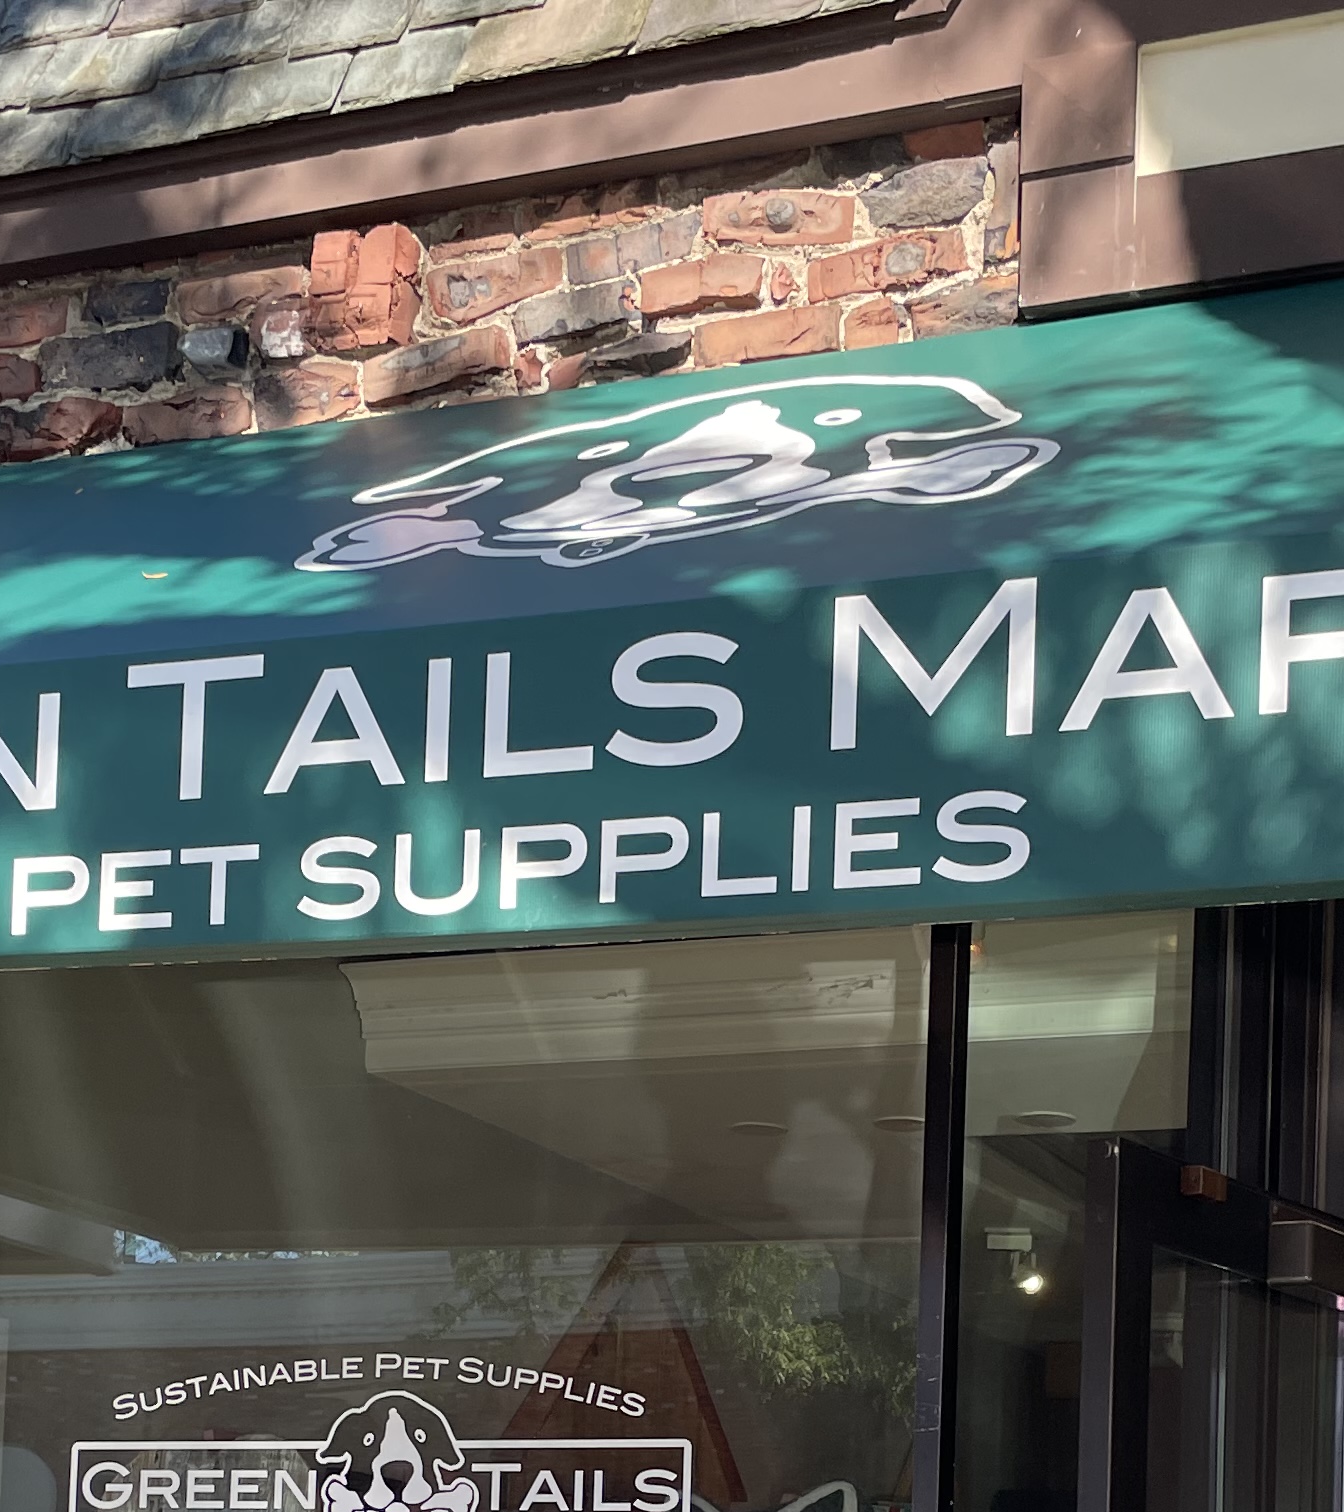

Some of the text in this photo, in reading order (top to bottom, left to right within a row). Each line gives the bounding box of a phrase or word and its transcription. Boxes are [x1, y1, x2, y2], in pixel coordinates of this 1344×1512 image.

[127, 632, 744, 799] TAILS
[10, 790, 1031, 937] PET SUPPLIES
[112, 1353, 646, 1420] SUSTAINABLE PET SUPPLIES
[81, 1461, 317, 1511] GREEN
